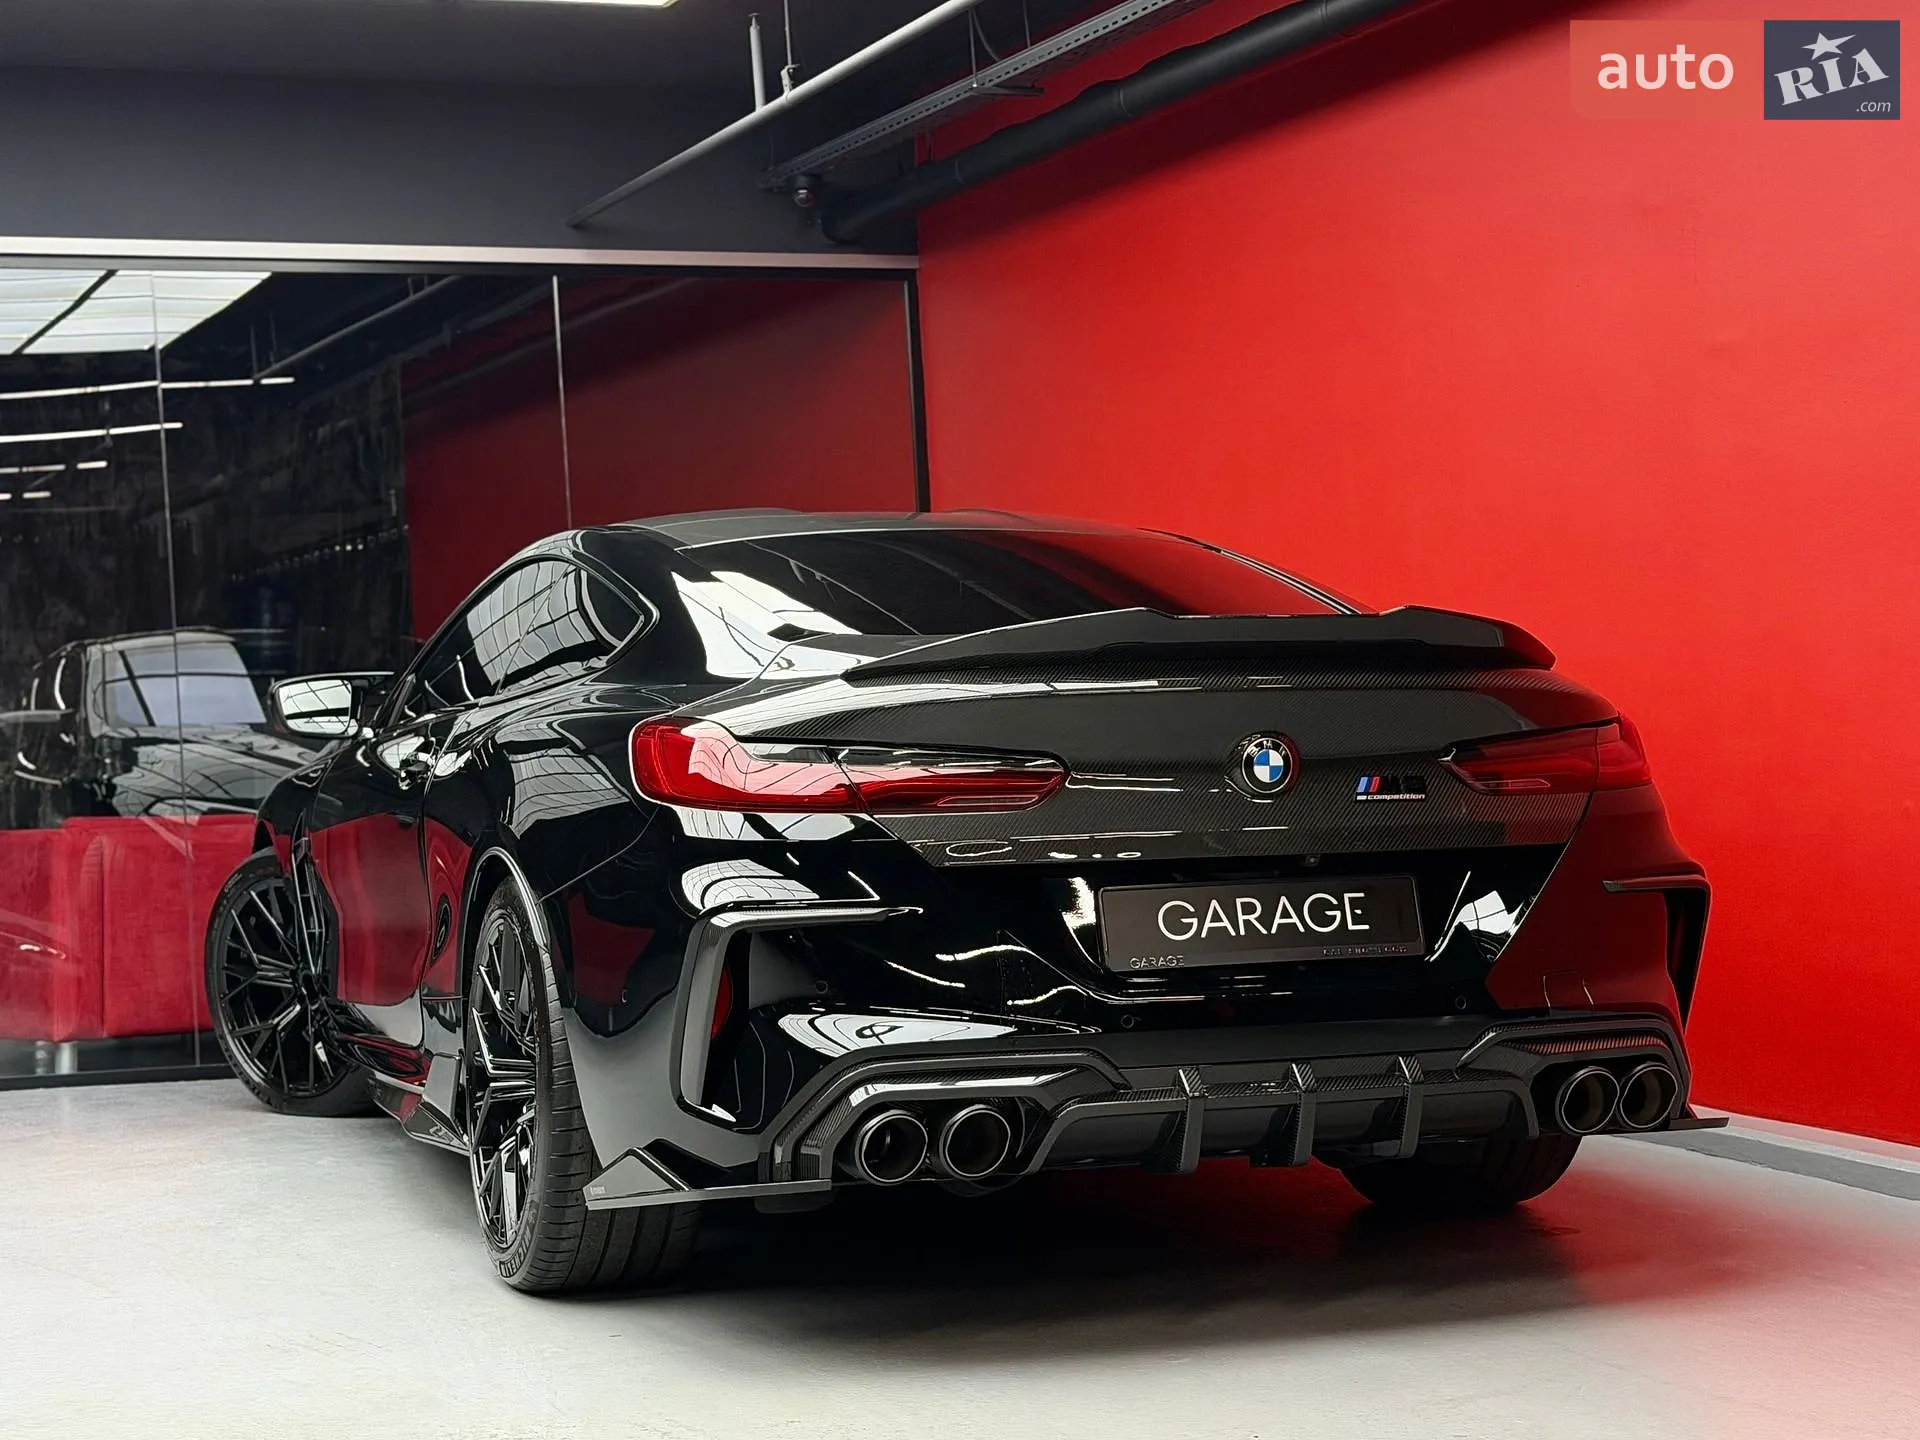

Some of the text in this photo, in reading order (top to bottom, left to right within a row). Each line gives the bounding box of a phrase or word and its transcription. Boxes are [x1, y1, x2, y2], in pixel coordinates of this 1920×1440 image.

[1367, 793, 1426, 801] competition
[1157, 892, 1370, 941] GARAGE
[1130, 955, 1184, 968] GARAGE
